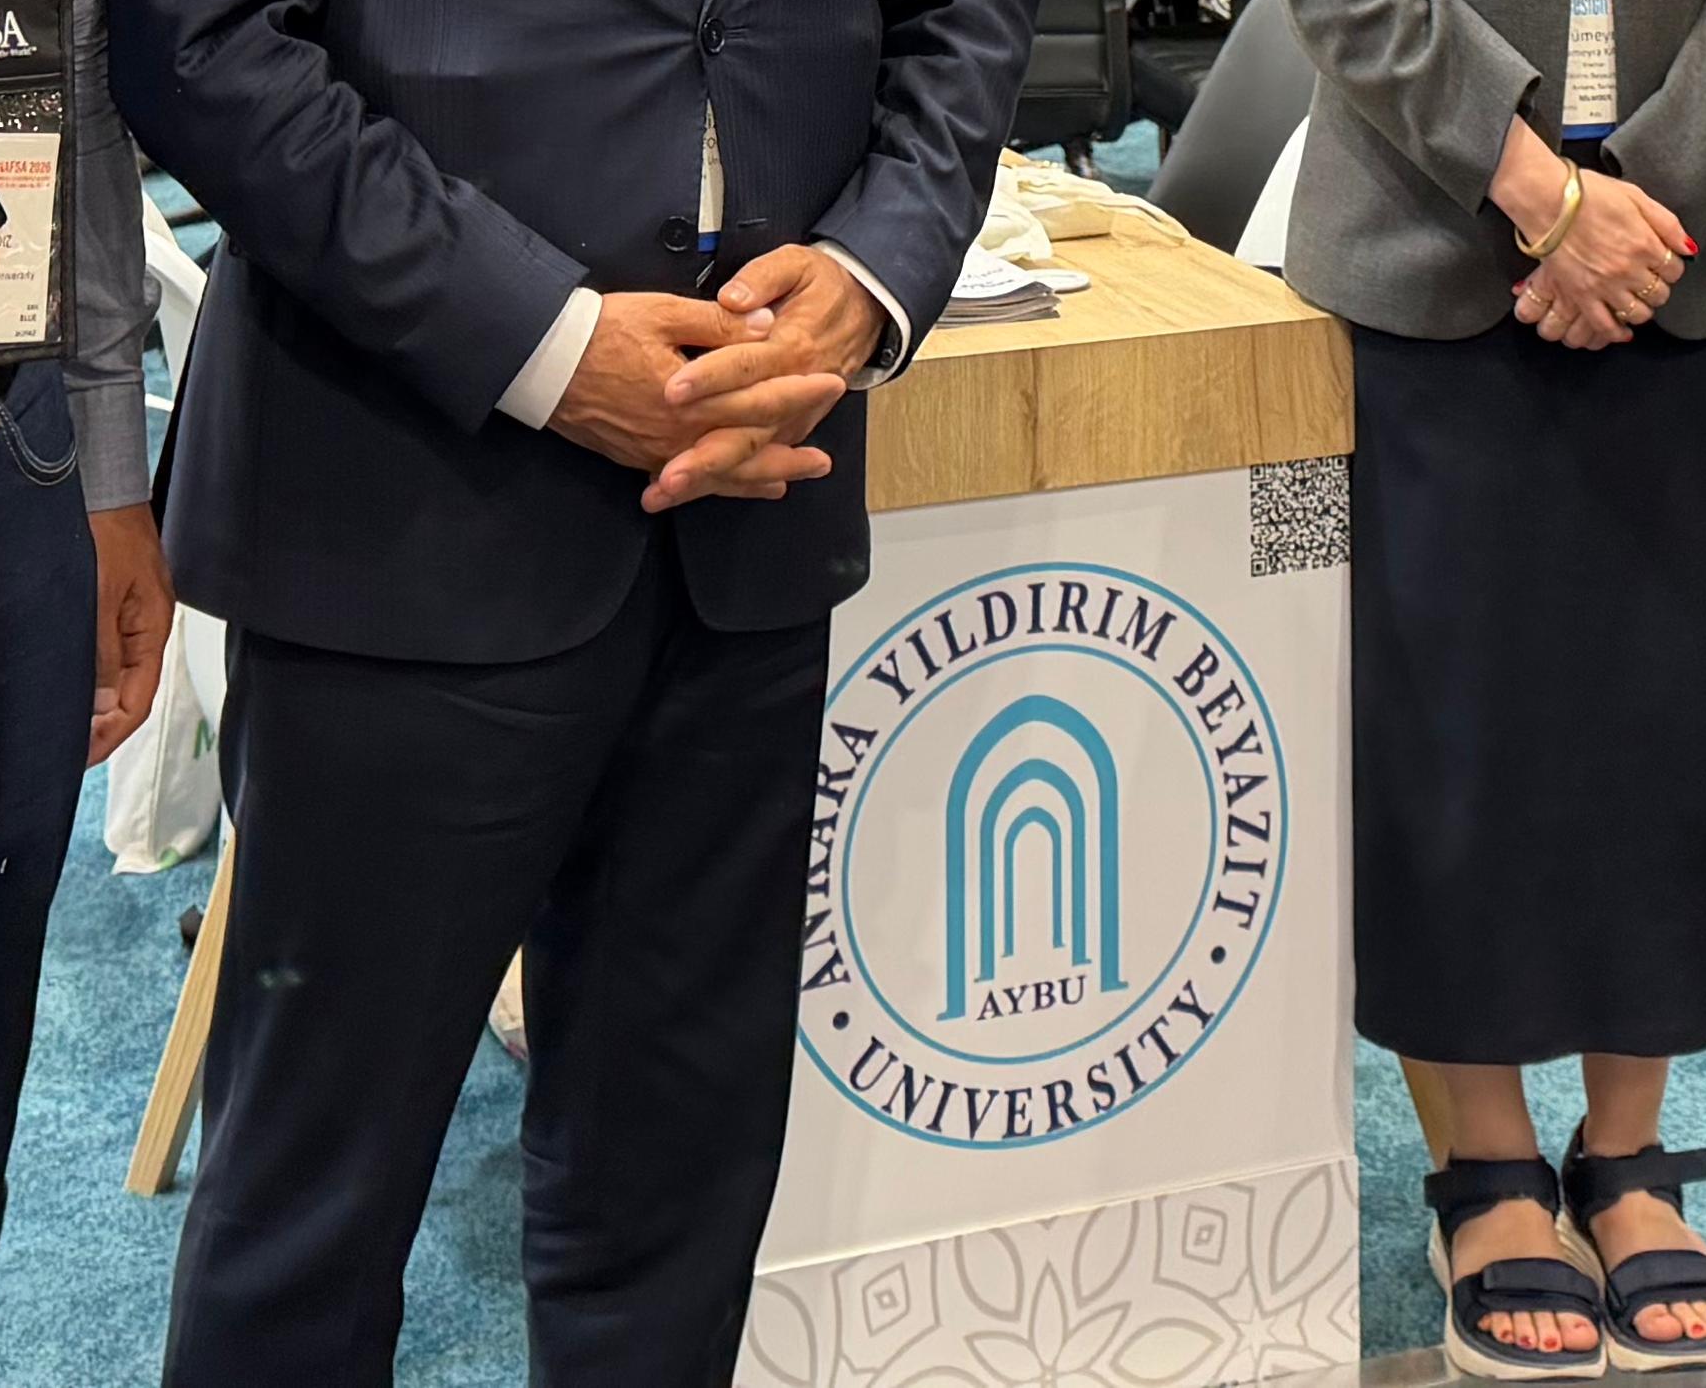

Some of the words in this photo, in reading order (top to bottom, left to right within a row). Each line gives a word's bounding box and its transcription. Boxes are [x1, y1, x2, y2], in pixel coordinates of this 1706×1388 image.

[867, 580, 1178, 706] YILDIRIM
[1173, 643, 1272, 931] BEYAZIT
[848, 978, 1218, 1143] UNIVERSITY
[975, 975, 1089, 1021] AYBU
